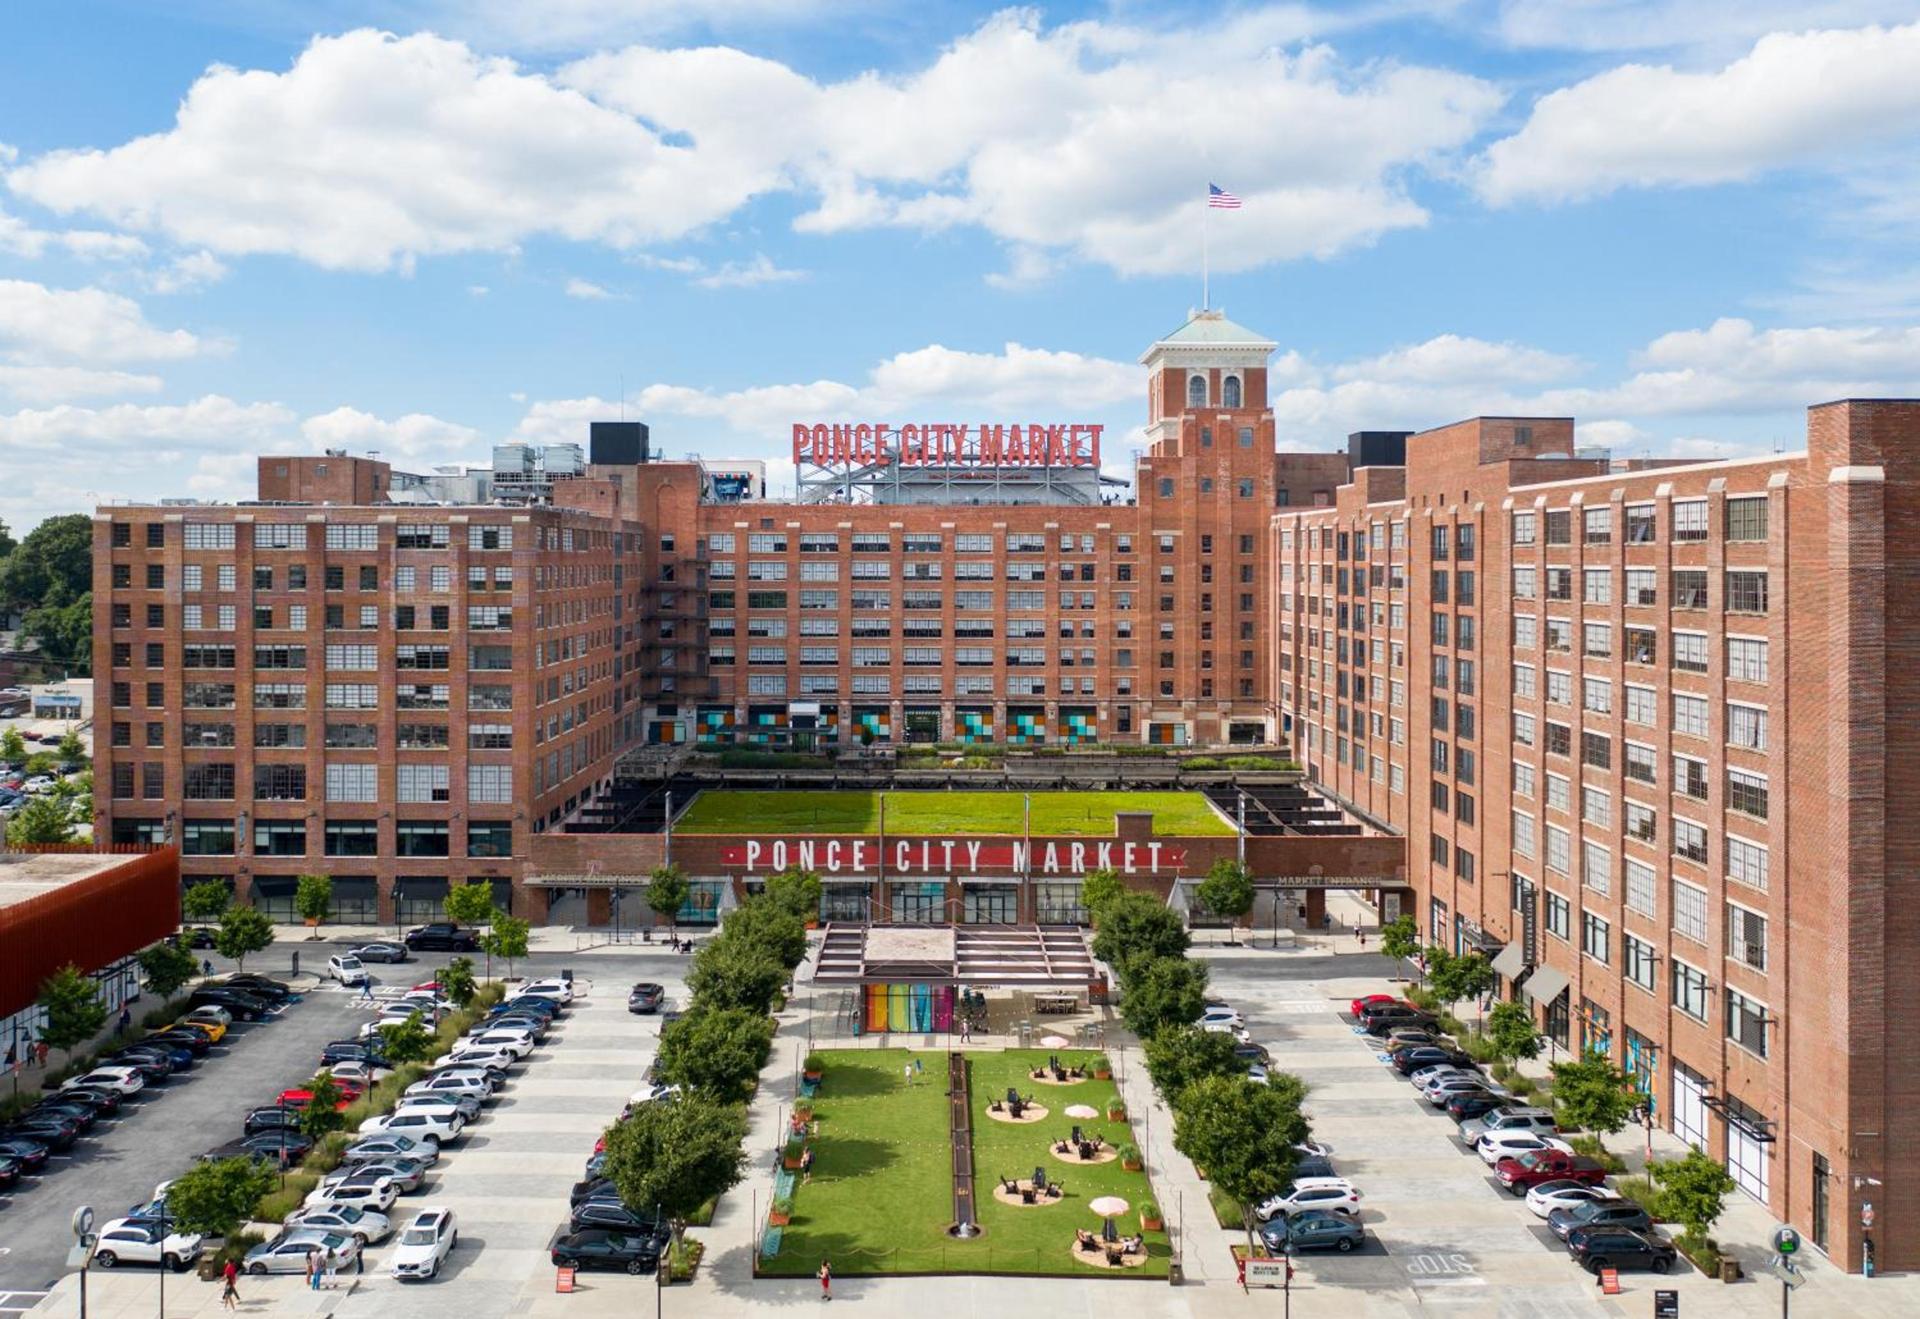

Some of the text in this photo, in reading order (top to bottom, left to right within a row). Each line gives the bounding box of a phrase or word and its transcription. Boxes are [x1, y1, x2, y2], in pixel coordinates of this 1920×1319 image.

[792, 423, 1104, 468] PONCE CITY MARKET
[746, 840, 1162, 873] PONCE CITY MARKET
[1278, 876, 1321, 886] MARKET
[1781, 1229, 1794, 1242] P
[1406, 1253, 1474, 1274] STOP
